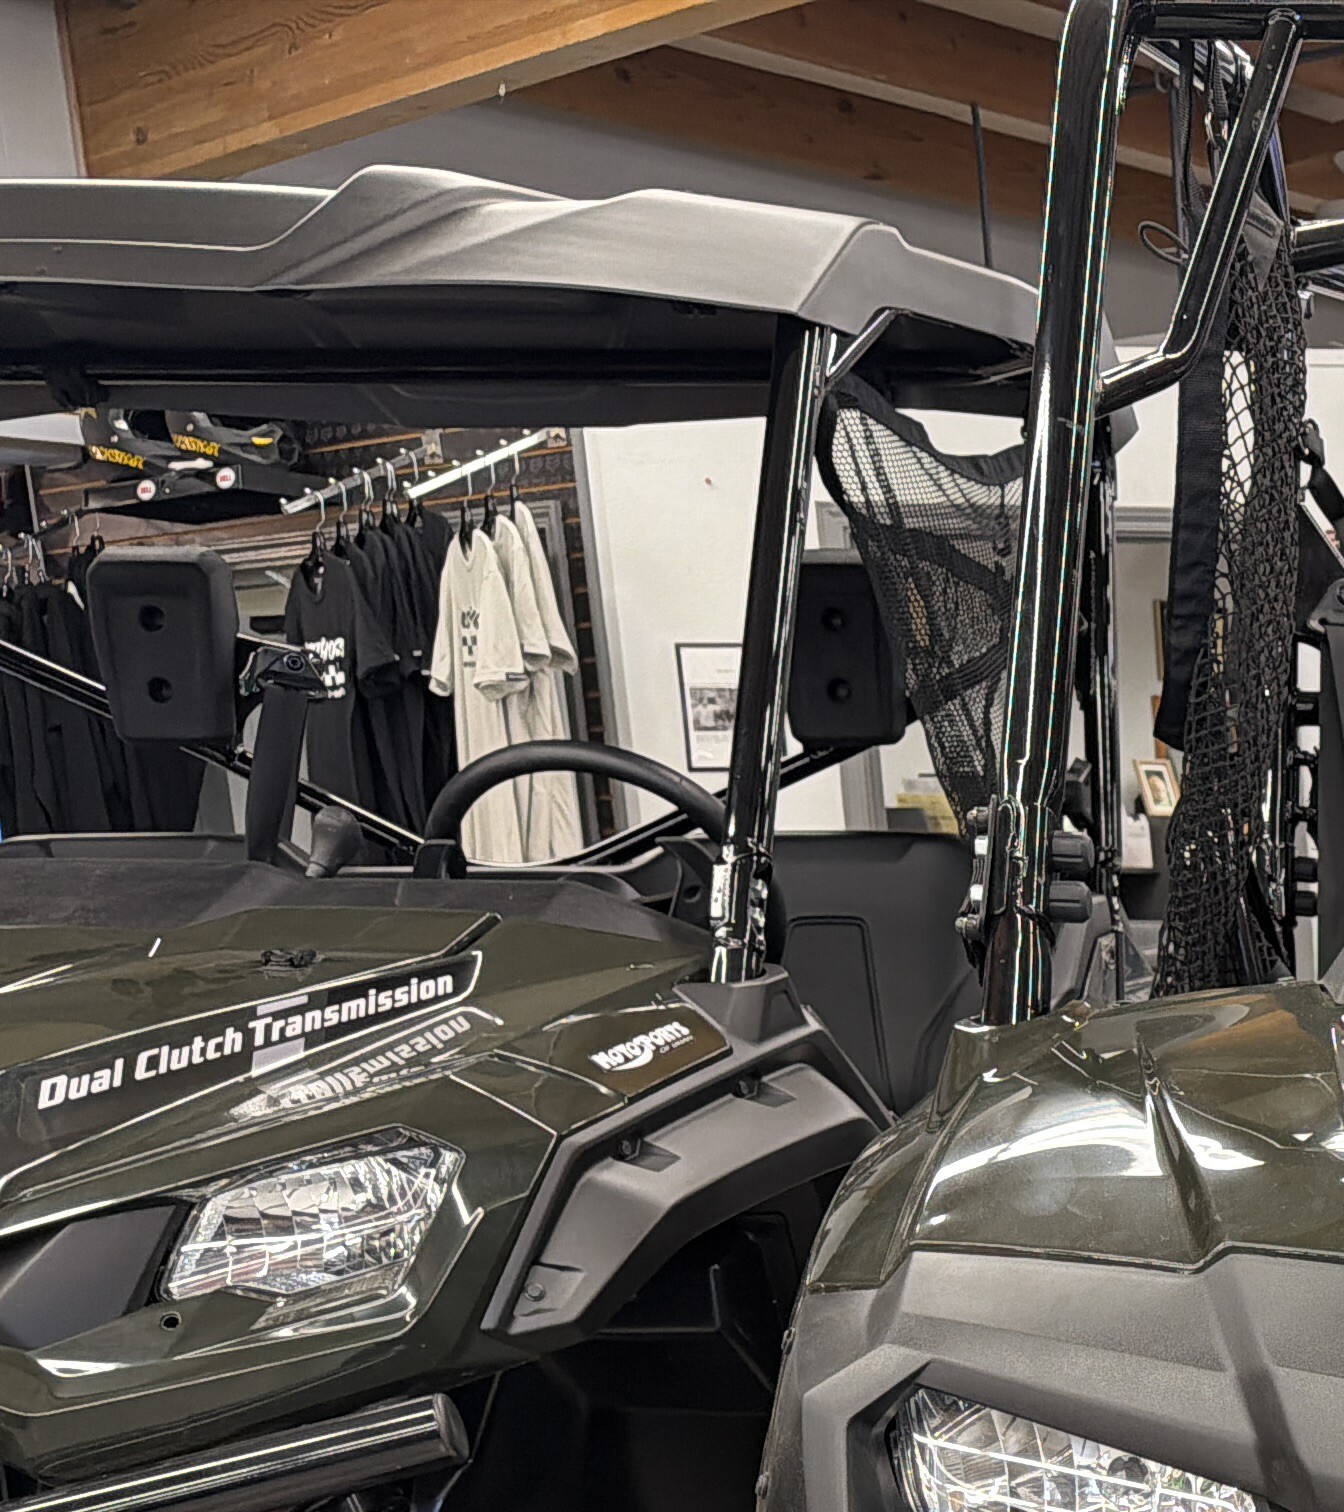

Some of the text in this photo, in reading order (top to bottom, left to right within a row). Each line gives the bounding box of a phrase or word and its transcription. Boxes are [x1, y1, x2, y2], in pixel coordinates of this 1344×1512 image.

[37, 973, 454, 1110] Dual Clutch Transmission
